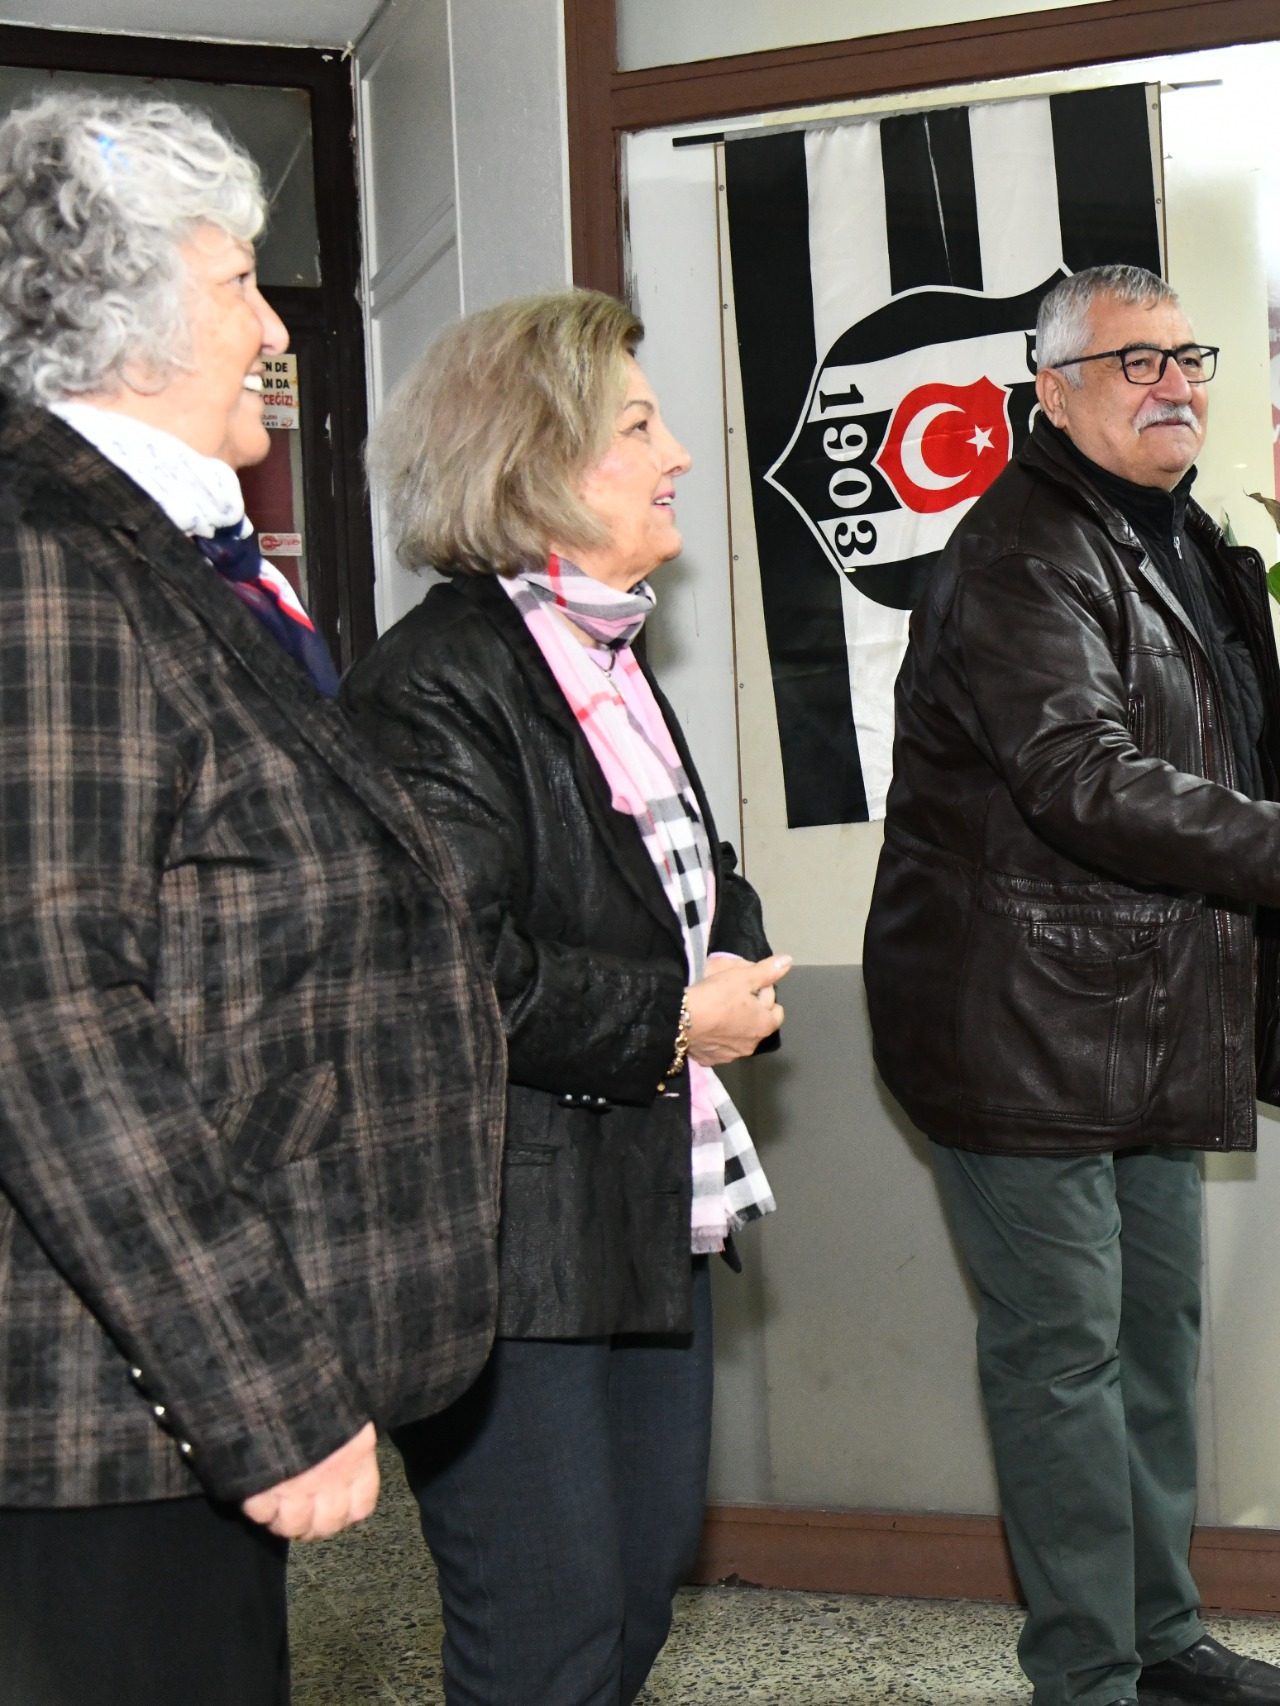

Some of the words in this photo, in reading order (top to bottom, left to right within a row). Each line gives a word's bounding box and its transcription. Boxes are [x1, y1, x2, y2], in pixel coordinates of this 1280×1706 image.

[275, 361, 288, 373] DE
[275, 378, 290, 389] DA
[819, 383, 877, 558] 1903
